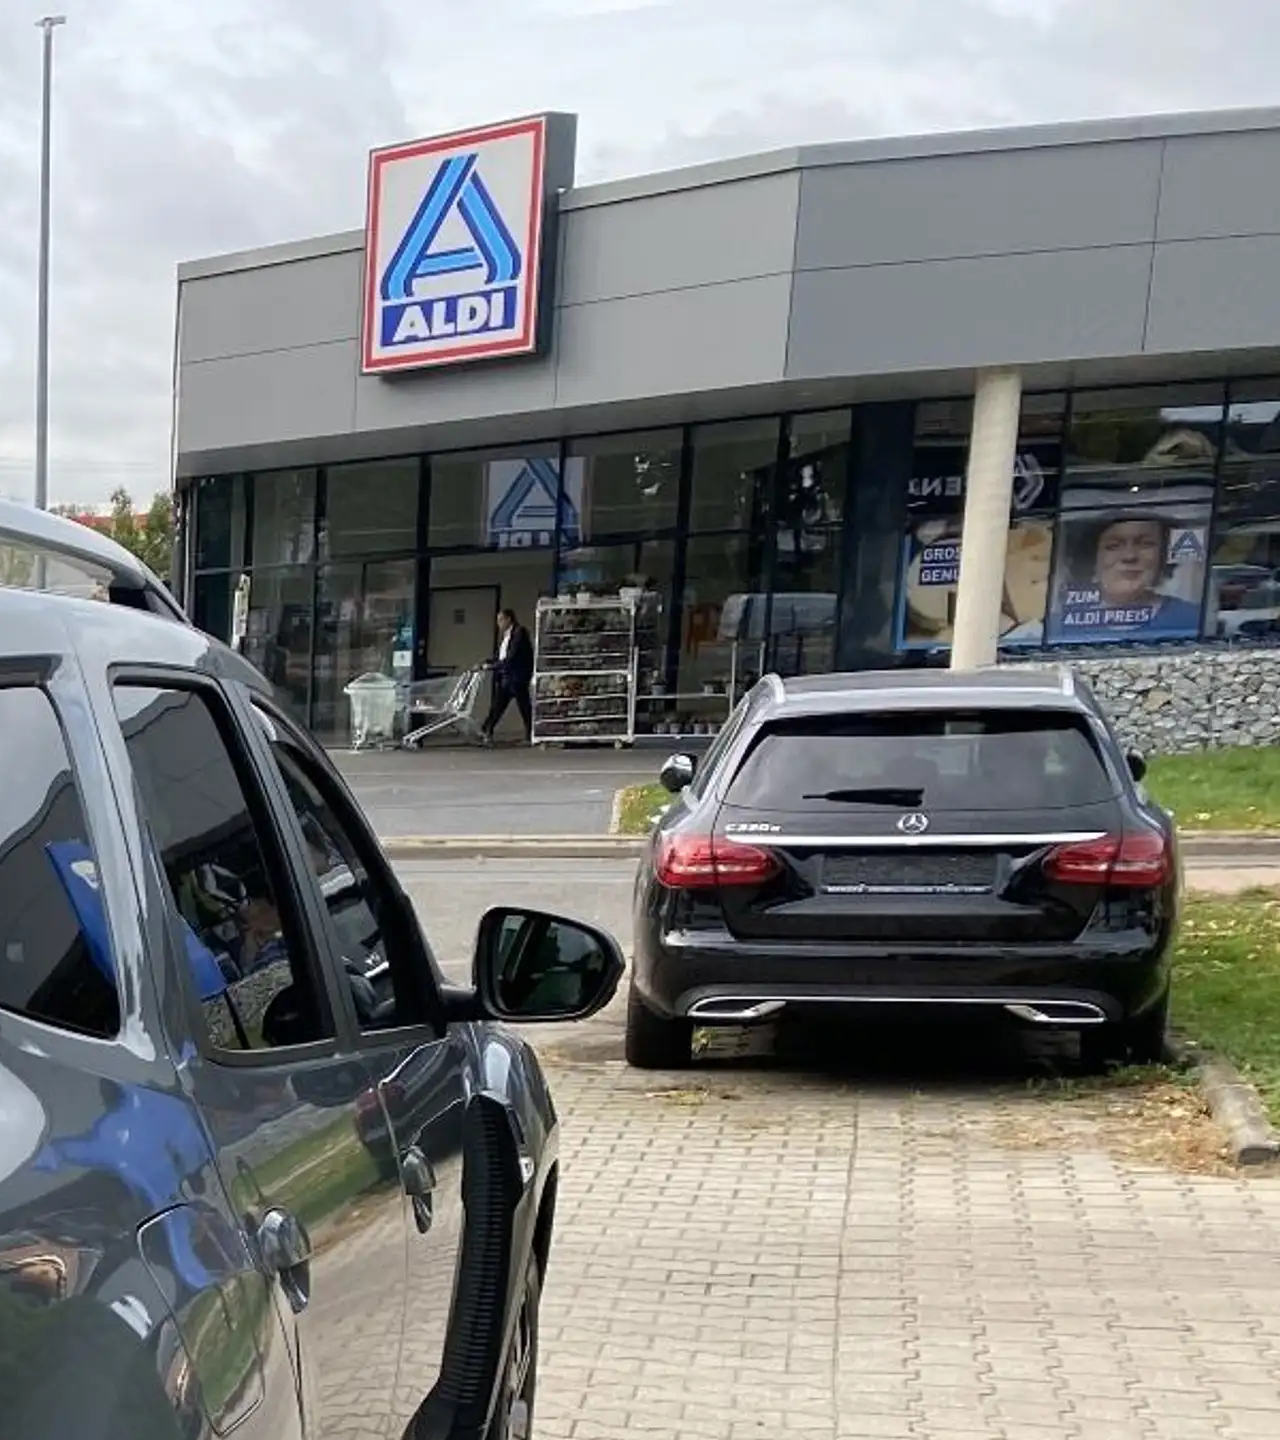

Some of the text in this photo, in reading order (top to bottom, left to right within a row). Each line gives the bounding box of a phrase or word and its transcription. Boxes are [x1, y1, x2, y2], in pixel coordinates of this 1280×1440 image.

[392, 291, 505, 342] ALDI
[1066, 590, 1100, 604] ZUM
[1064, 610, 1099, 625] ALDI
